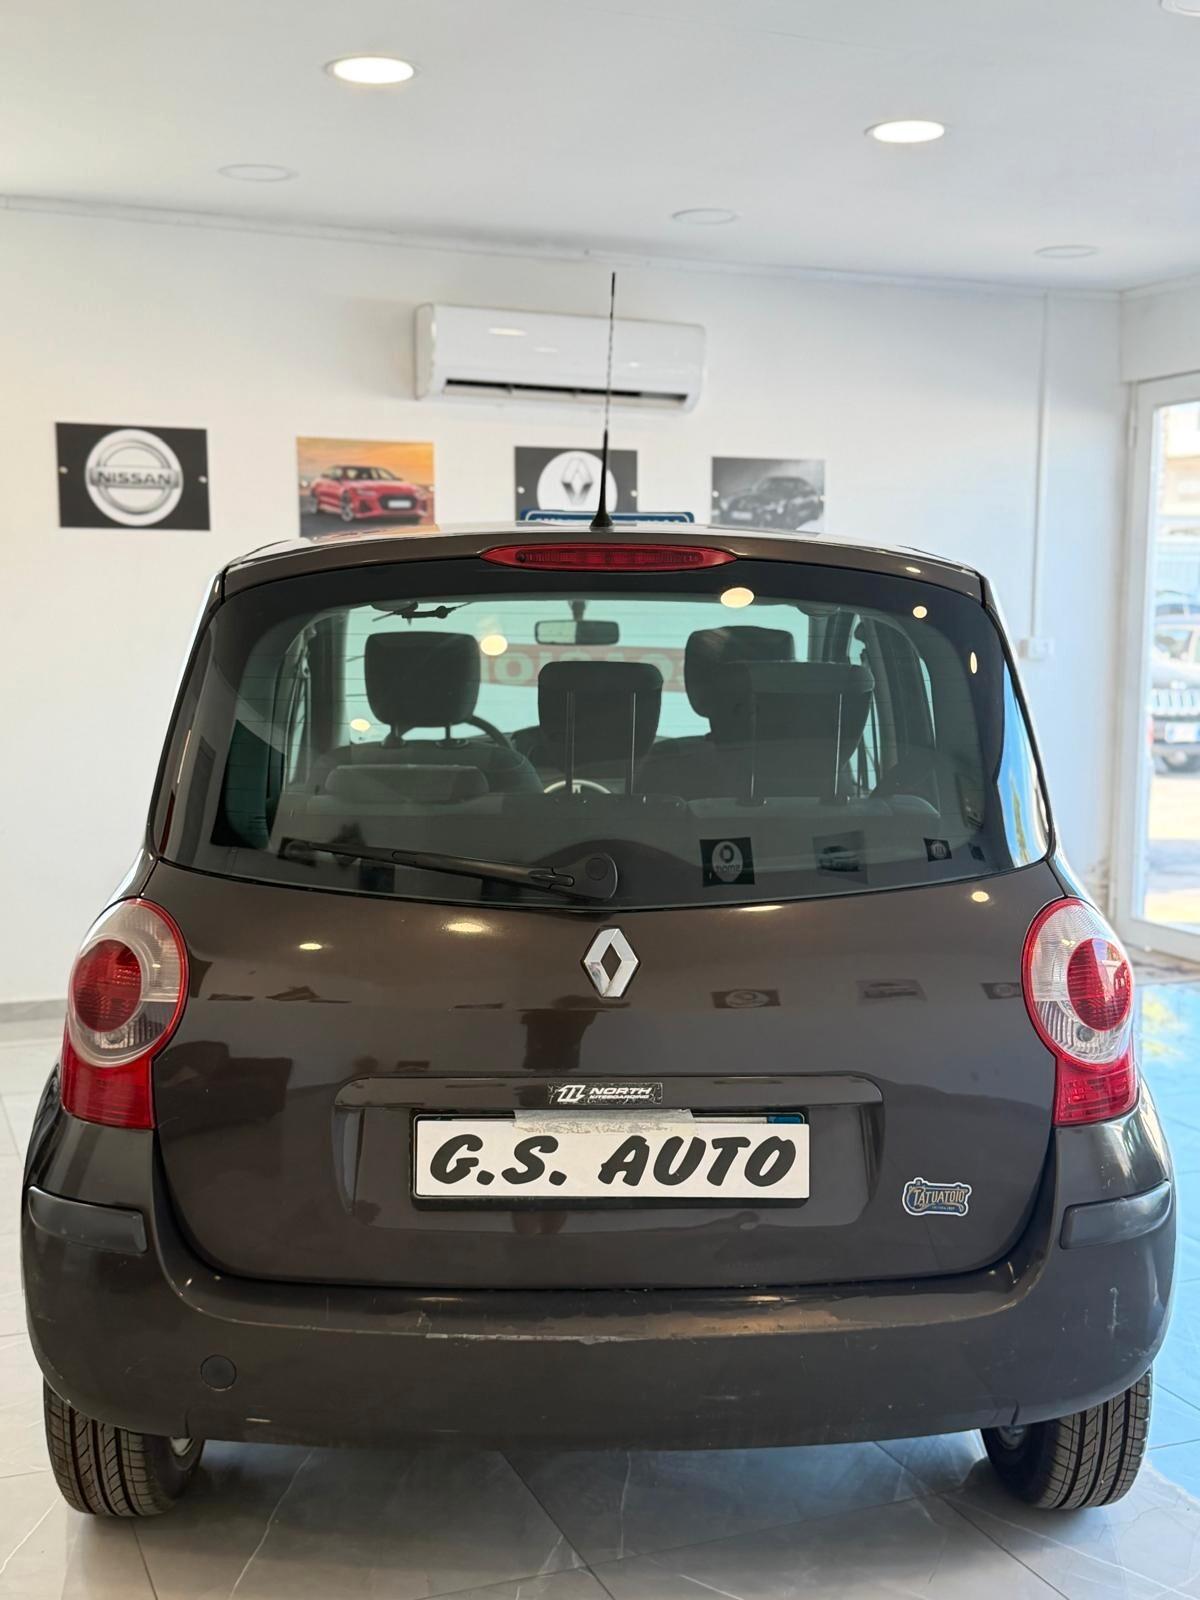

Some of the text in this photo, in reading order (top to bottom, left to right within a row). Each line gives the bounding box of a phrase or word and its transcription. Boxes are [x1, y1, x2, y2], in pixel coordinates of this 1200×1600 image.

[97, 471, 171, 486] NISSAN
[589, 1087, 652, 1095] NORTH
[430, 1133, 797, 1188] G.S. AUTO
